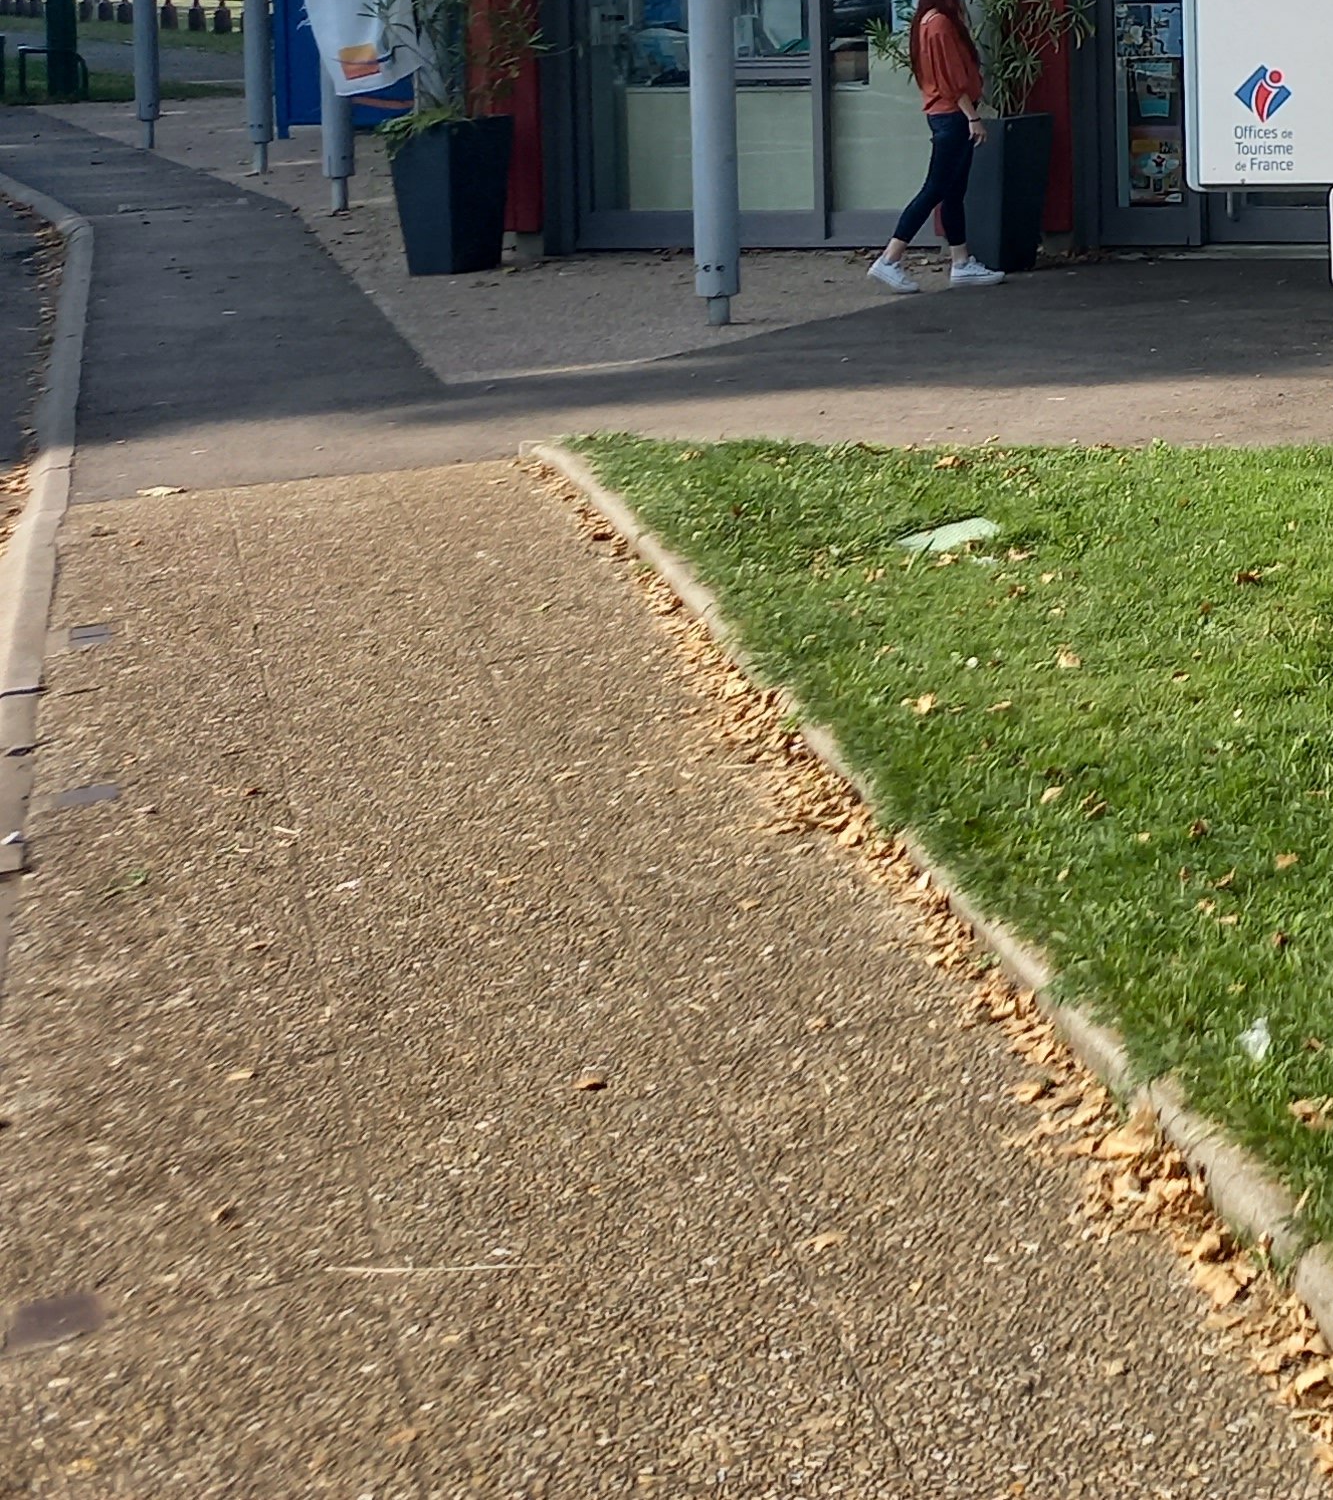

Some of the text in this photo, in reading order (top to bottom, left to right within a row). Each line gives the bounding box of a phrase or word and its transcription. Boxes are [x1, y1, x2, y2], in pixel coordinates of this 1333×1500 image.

[1234, 125, 1293, 139] Offices de
[1235, 141, 1294, 155] Tourisme
[1234, 157, 1294, 171] de France
